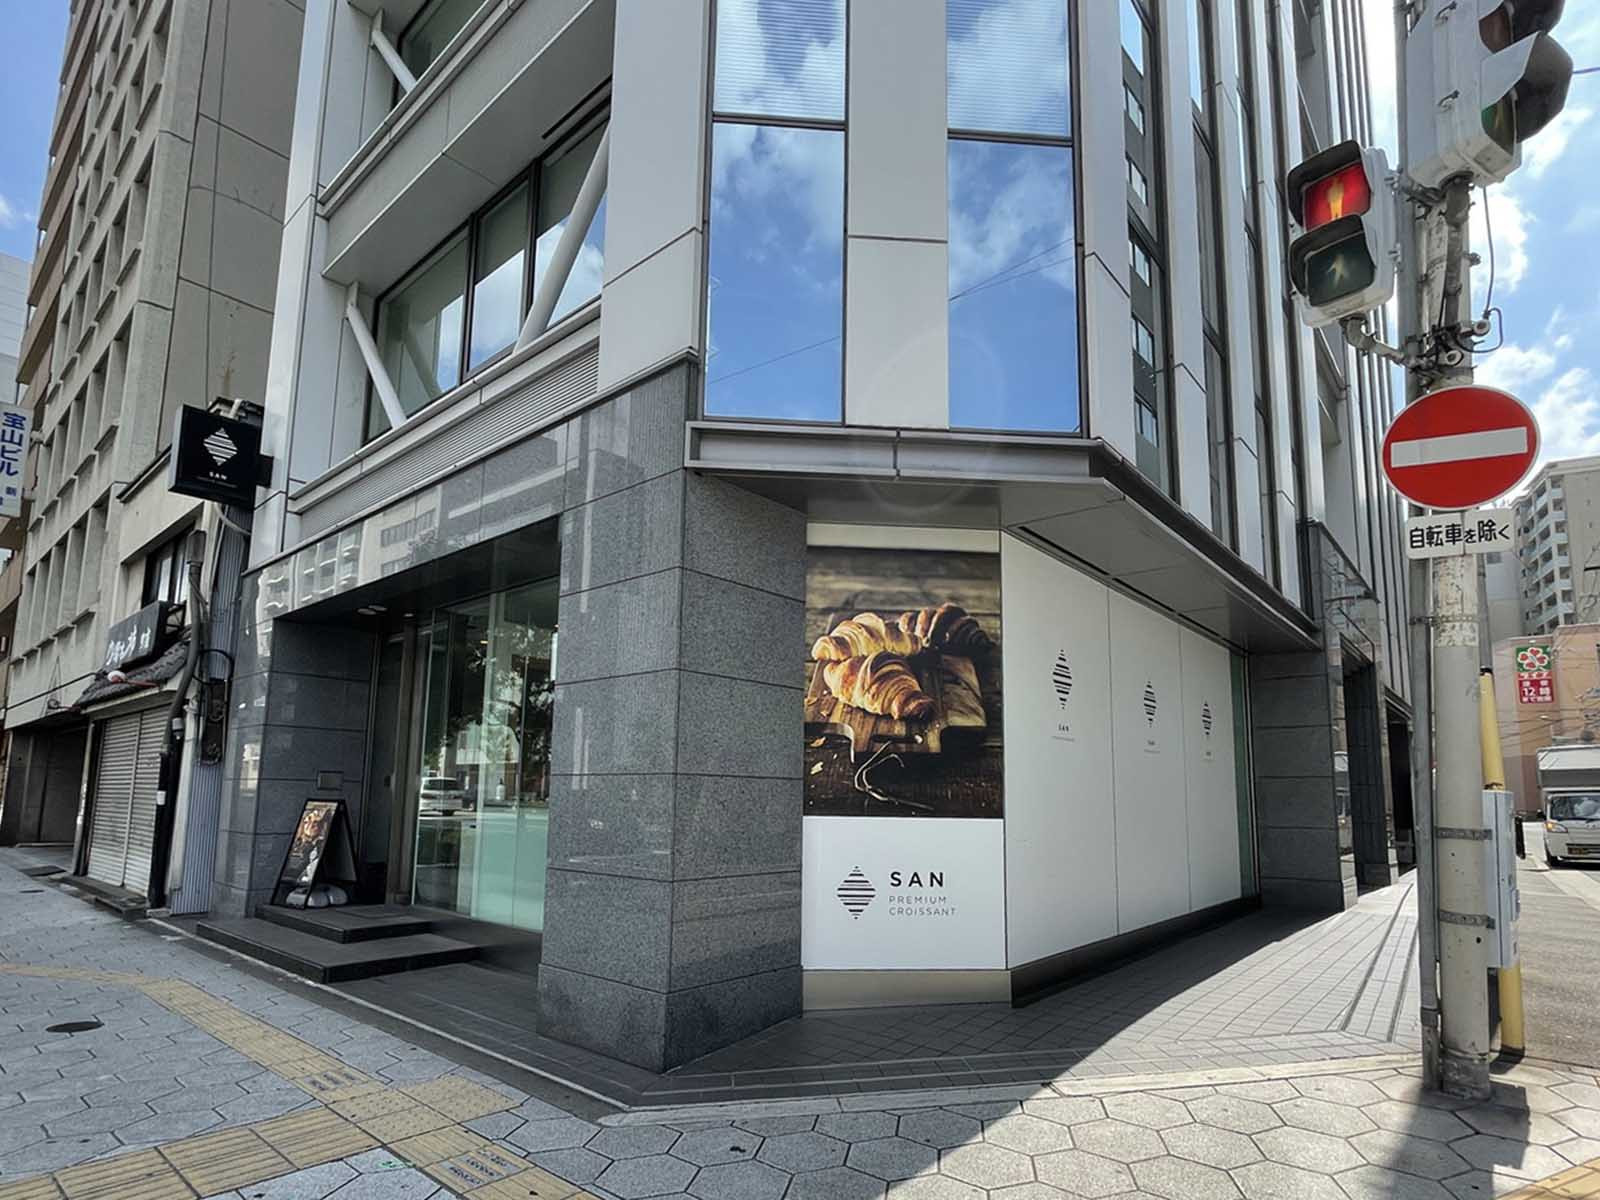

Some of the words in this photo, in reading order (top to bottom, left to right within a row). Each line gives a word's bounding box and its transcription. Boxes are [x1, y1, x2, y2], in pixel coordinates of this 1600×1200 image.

[0, 411, 27, 476] 宝山ビル
[1409, 518, 1511, 549] 自転車を除く
[890, 871, 944, 888] SAN
[888, 895, 947, 905] PREMIUM
[888, 907, 957, 917] CROISSANT
